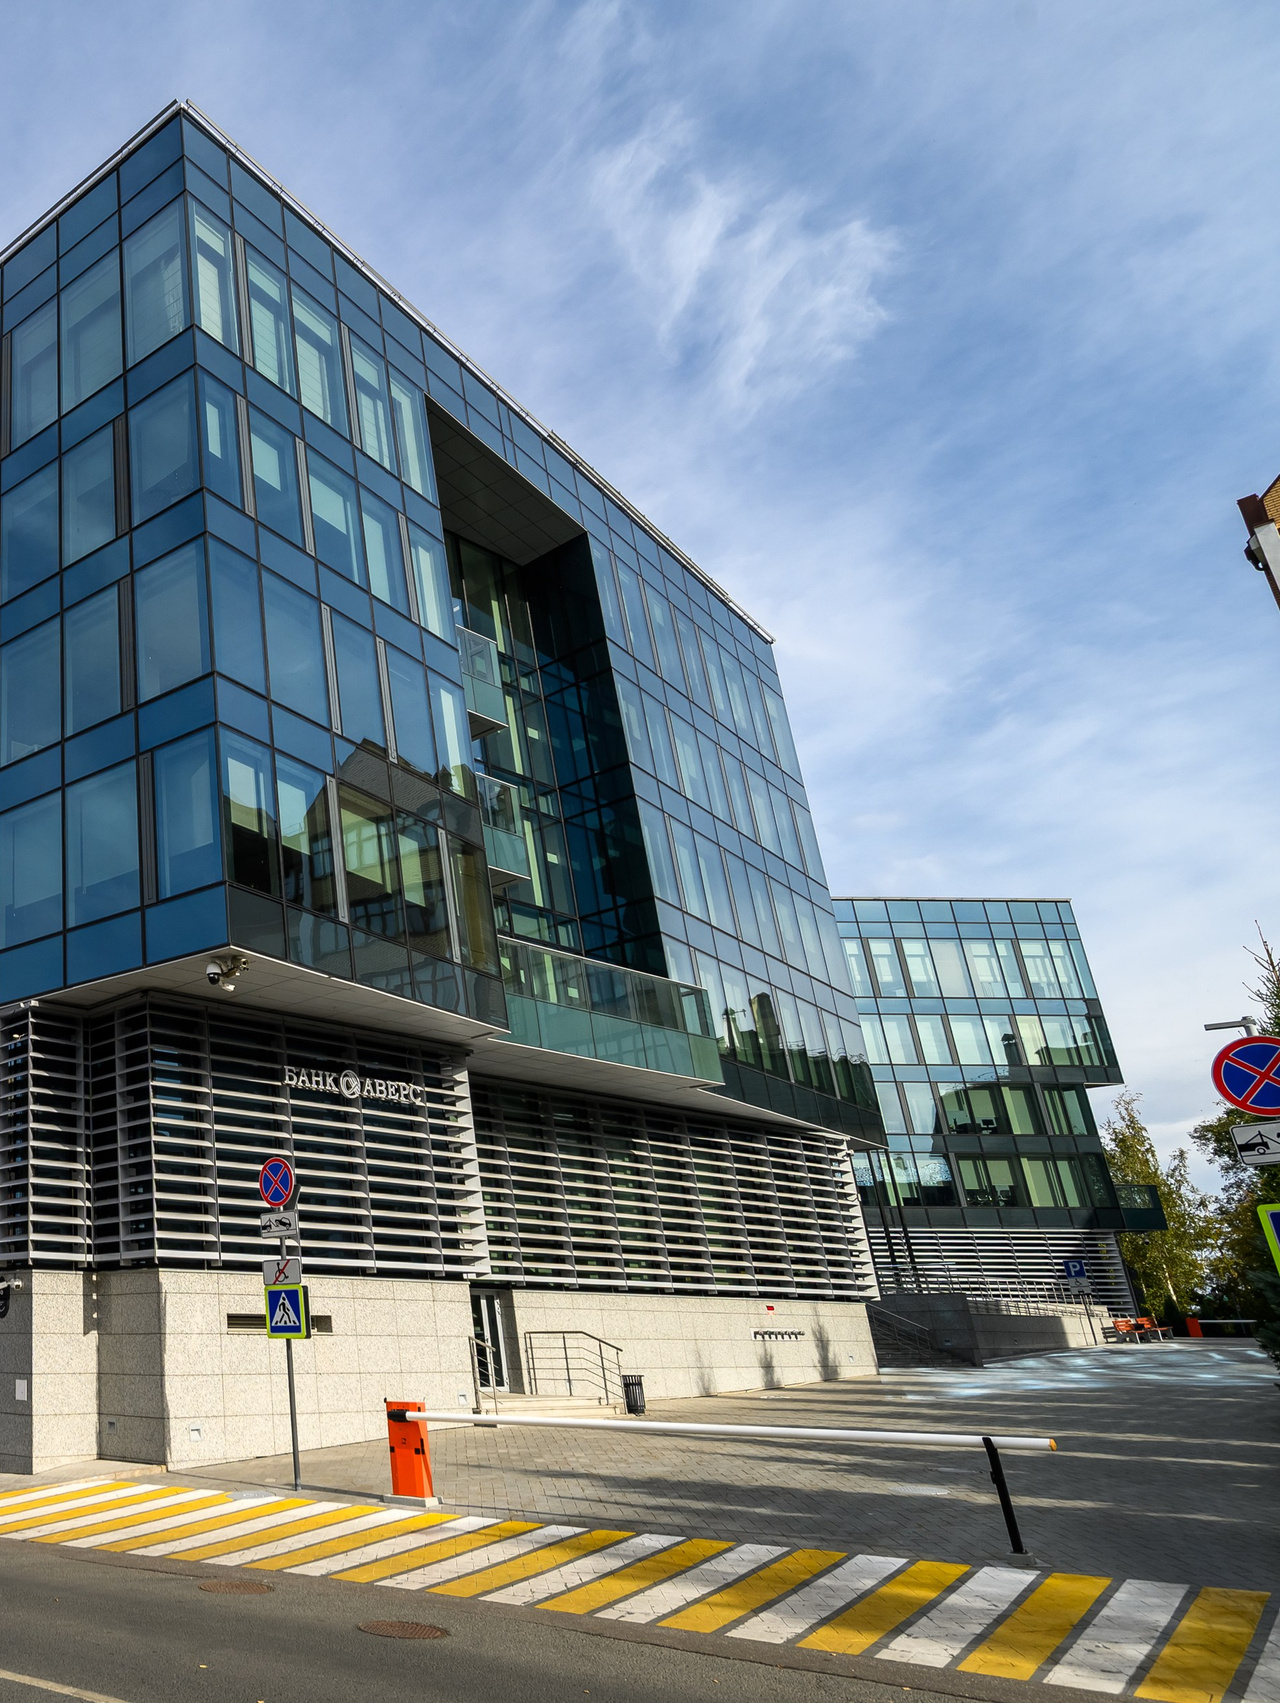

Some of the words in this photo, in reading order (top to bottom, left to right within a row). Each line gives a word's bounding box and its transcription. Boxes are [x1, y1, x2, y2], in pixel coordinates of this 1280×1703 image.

[283, 1066, 339, 1092] БАНК
[363, 1078, 422, 1104] АВЕРС
[1068, 1262, 1081, 1276] P
